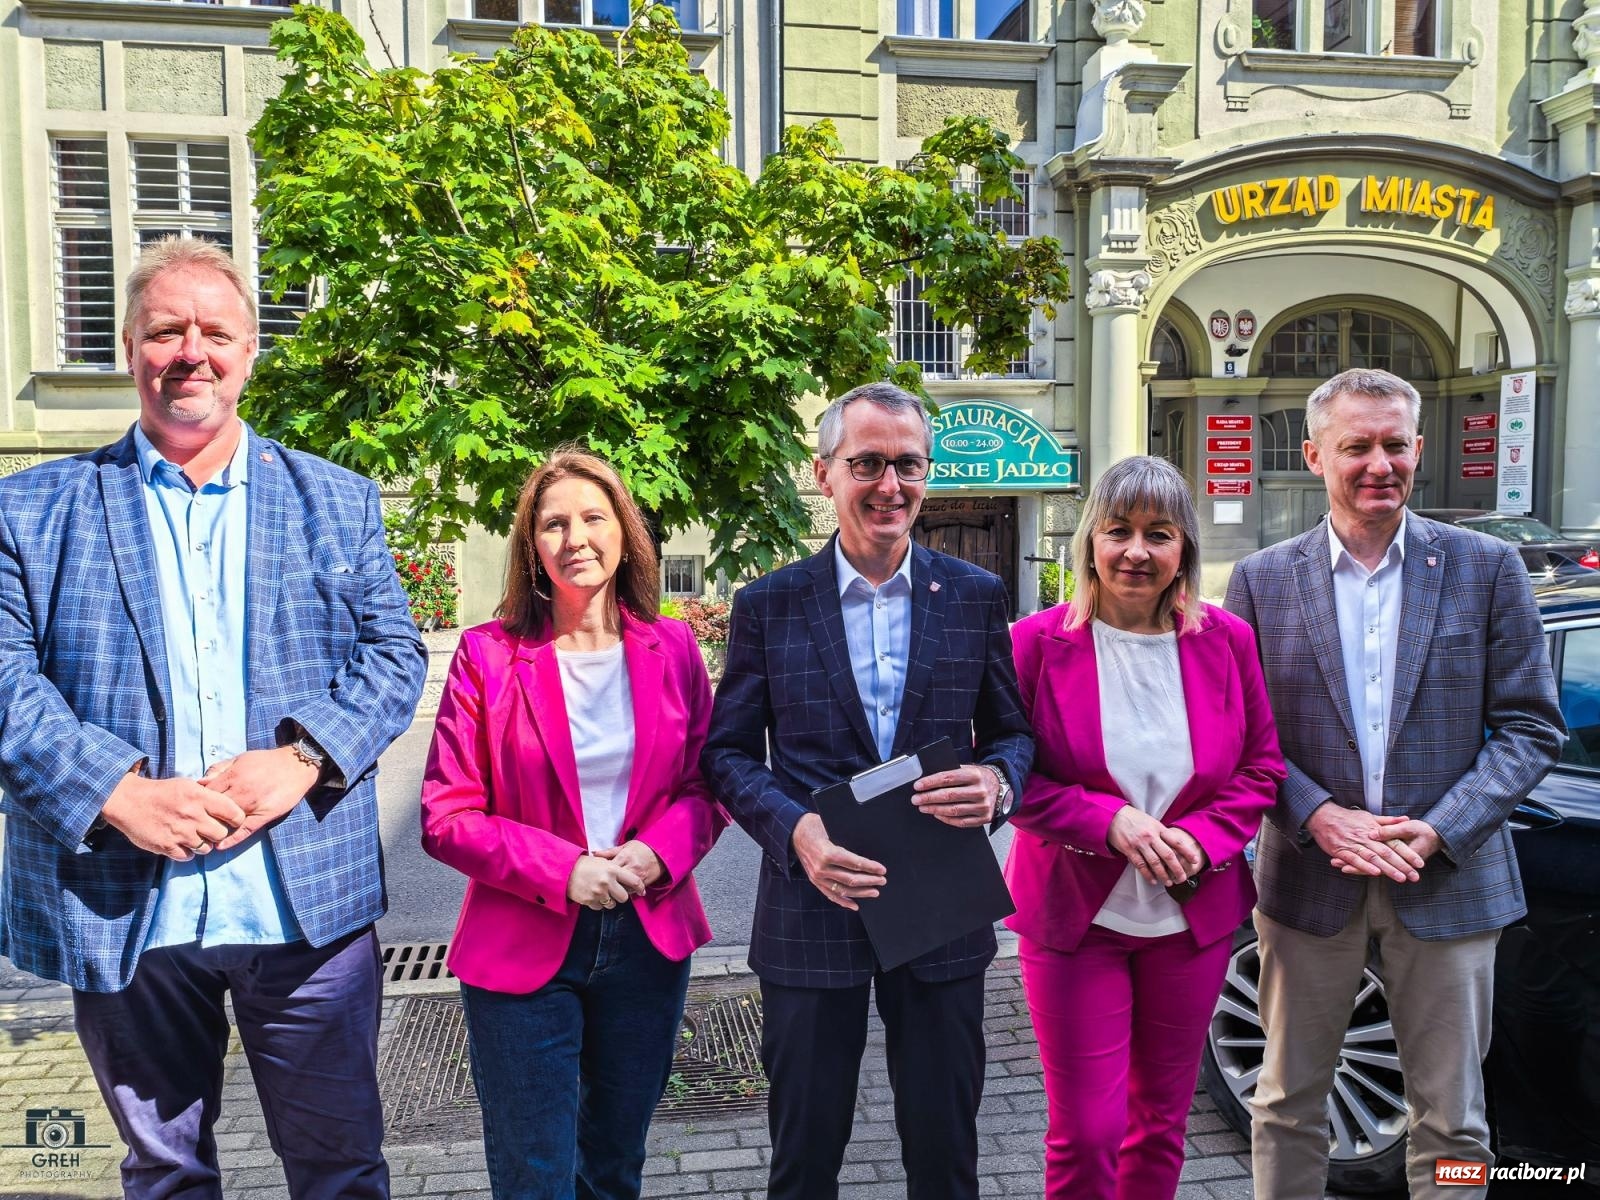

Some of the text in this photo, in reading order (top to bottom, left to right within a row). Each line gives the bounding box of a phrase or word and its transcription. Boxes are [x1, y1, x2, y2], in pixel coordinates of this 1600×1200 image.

[1212, 174, 1495, 231] URZĄD MIASTA
[1227, 362, 1233, 371] 6
[929, 408, 1042, 461] STAURACJA
[945, 438, 969, 448] 10.00
[976, 438, 1000, 448] 24.00
[926, 458, 1073, 483] JSKIE JADŁO
